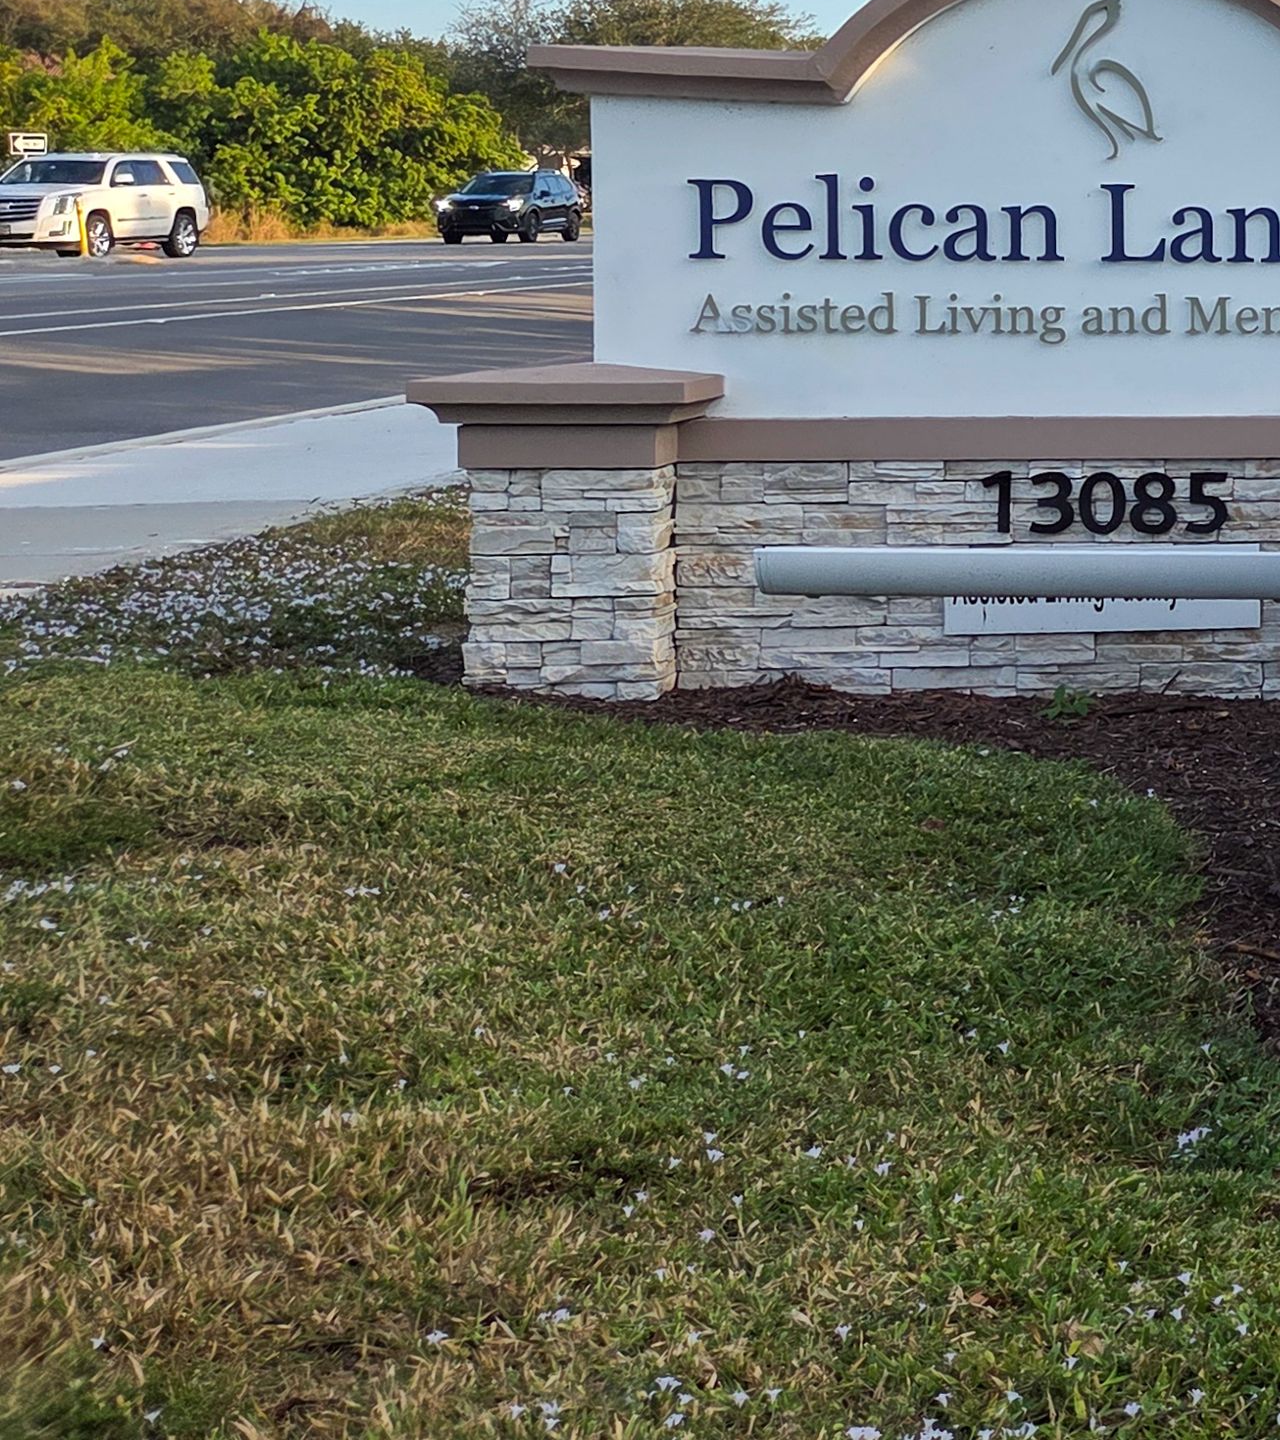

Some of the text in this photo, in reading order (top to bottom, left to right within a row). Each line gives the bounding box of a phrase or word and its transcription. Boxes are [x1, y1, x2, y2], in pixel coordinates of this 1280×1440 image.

[687, 175, 1065, 264] Pelican
[690, 292, 898, 335] Assisted
[914, 293, 1066, 344] Living
[1081, 294, 1170, 335] and
[982, 470, 1228, 535] 13085
